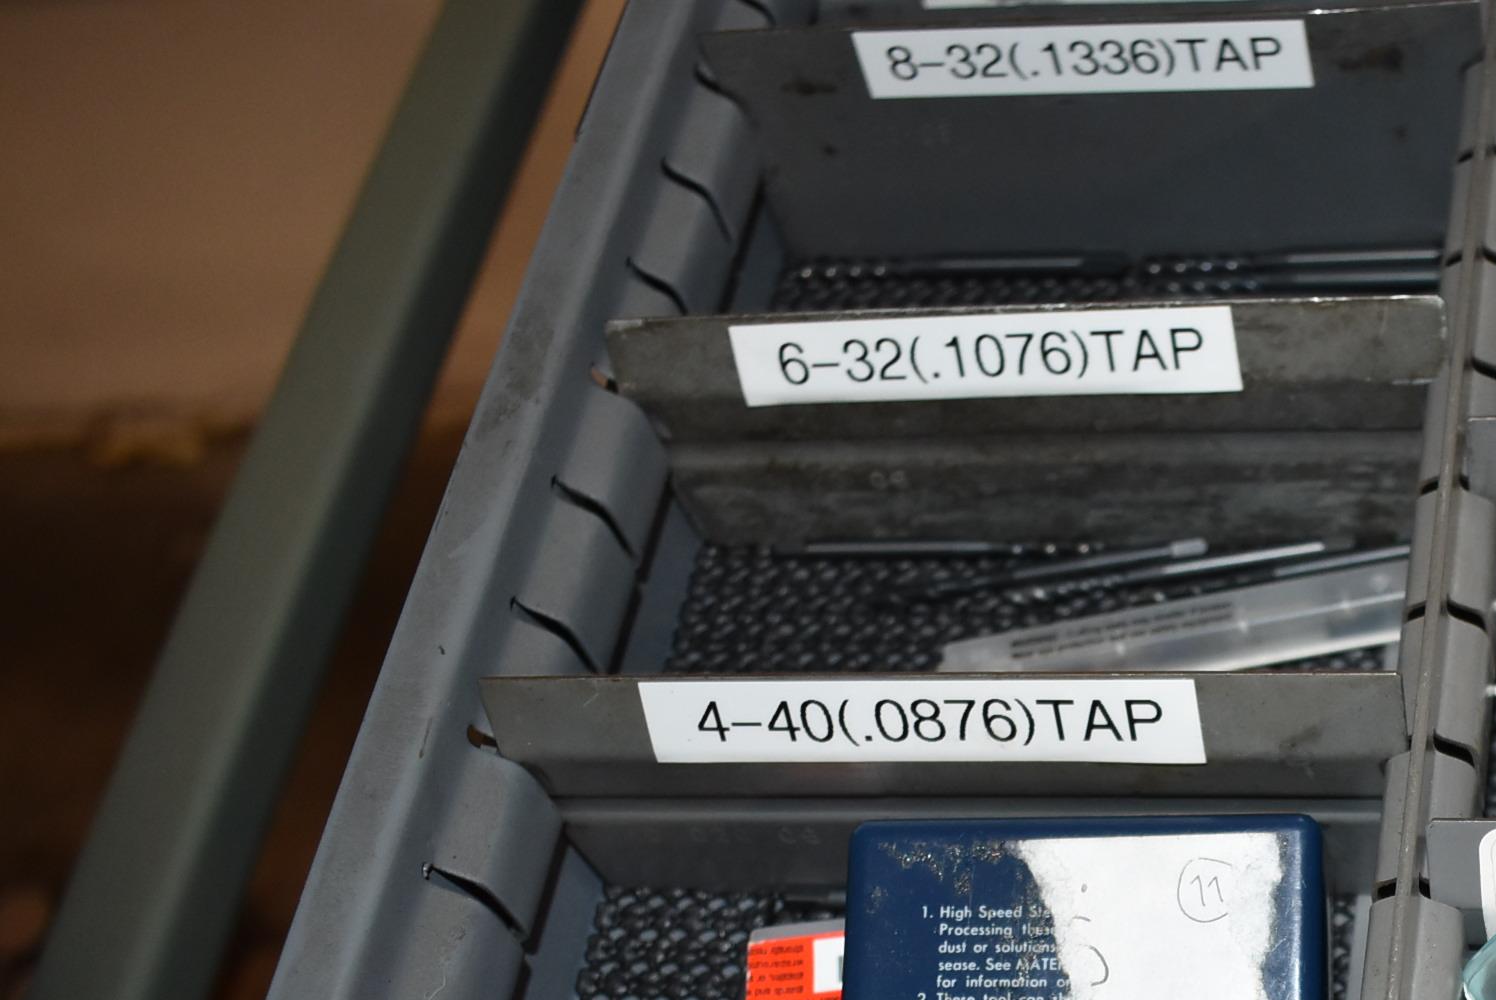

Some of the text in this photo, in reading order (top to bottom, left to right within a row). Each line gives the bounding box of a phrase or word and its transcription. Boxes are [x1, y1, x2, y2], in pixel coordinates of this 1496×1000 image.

[887, 36, 1284, 81] 8-32(.1336)TAP
[778, 327, 1205, 385] 6-32(.1076)TAP
[697, 697, 1165, 748] 4-40(.0876)TAP
[922, 906, 1022, 921] 1. High Speed
[939, 924, 1013, 938] Processing
[938, 942, 967, 953] dust
[973, 944, 988, 953] or
[938, 959, 1011, 972] sease. See
[936, 976, 1048, 988] for information
